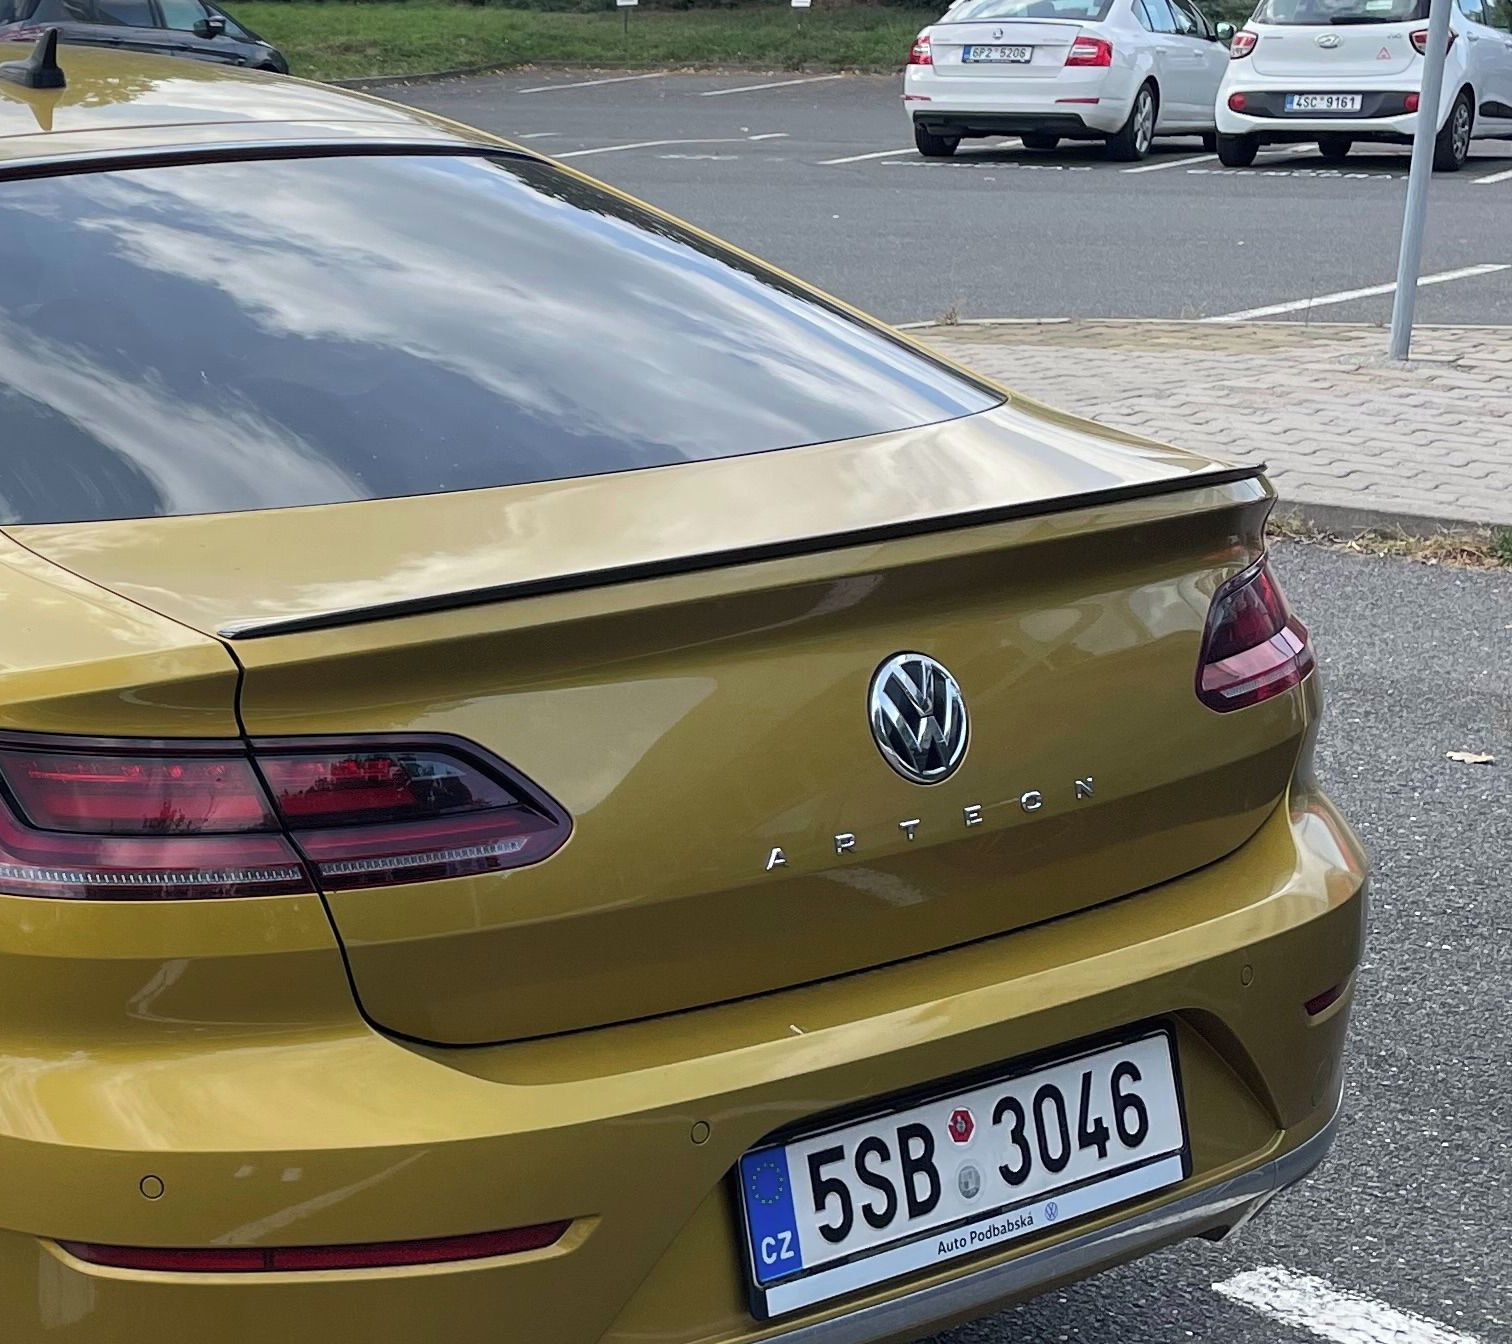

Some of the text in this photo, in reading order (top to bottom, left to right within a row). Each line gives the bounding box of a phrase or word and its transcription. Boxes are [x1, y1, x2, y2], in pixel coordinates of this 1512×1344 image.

[1295, 94, 1355, 108] 4SC 9161
[765, 775, 1094, 872] ARTEON
[806, 1060, 1150, 1244] 5SB 3046
[761, 1230, 795, 1265] CZ
[937, 1211, 1035, 1255] Auto Podbabská
